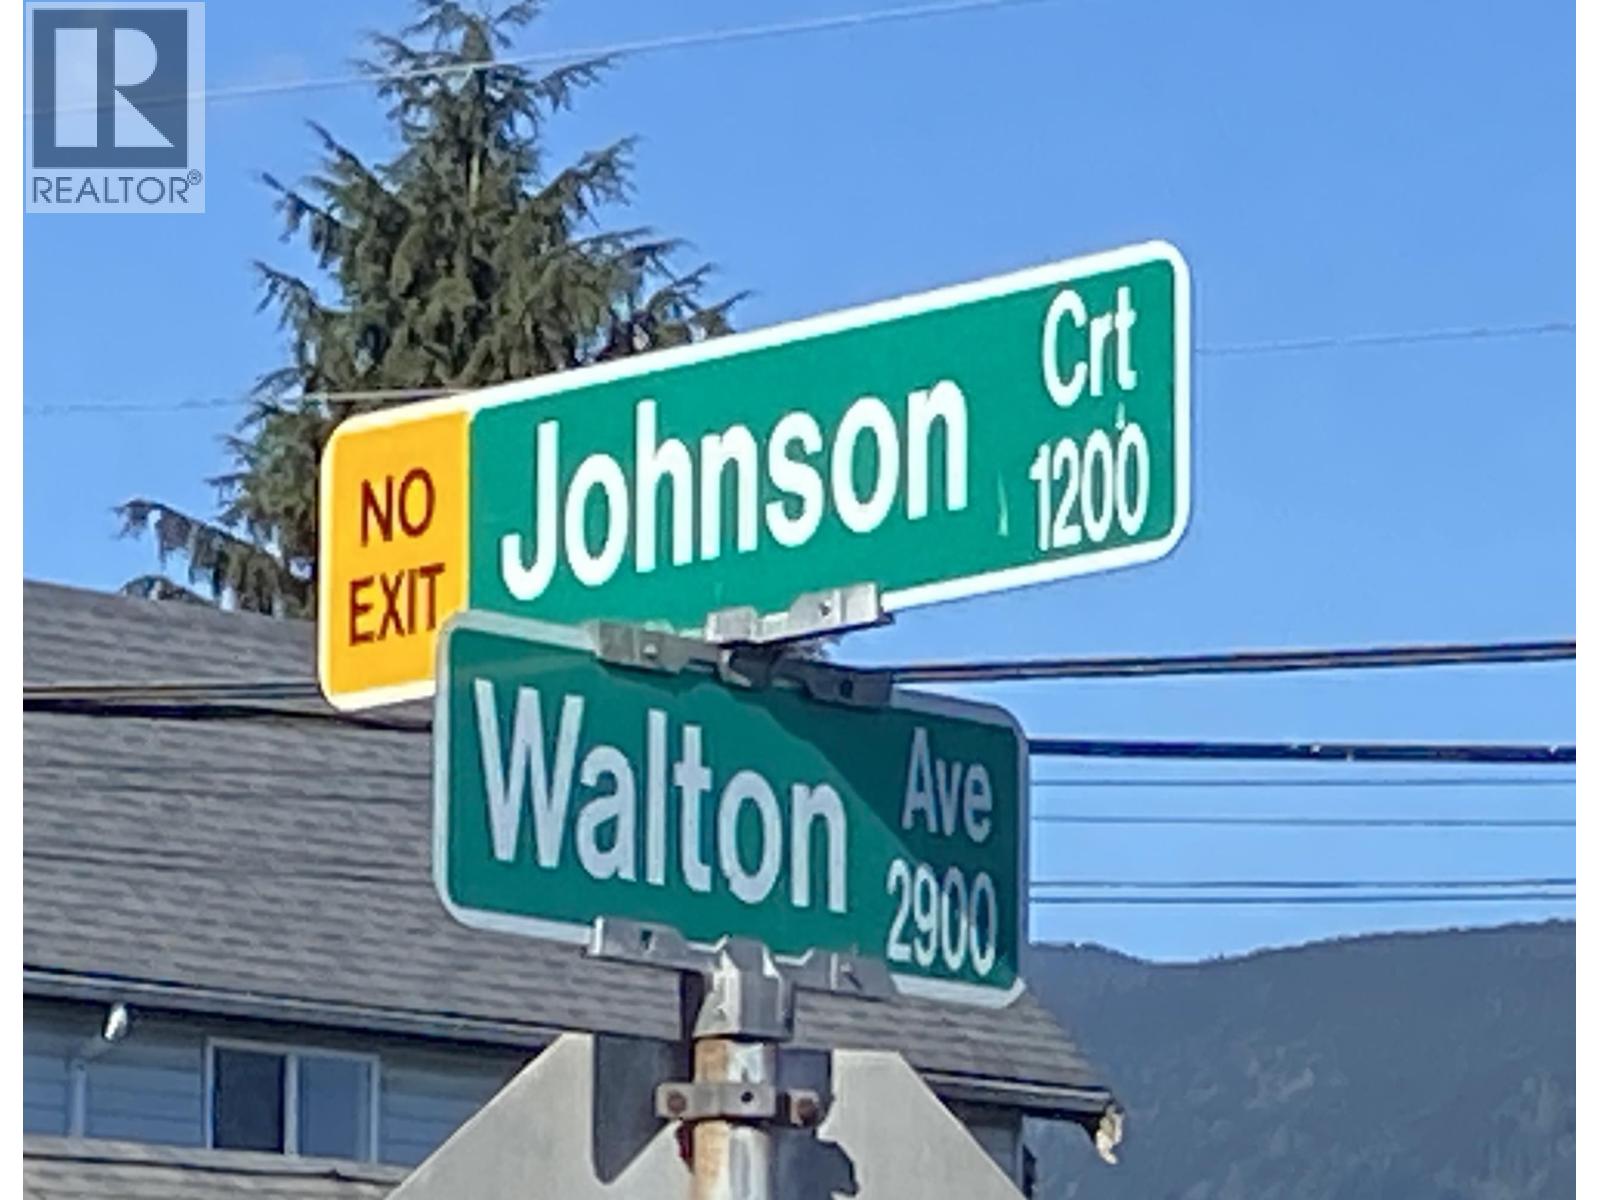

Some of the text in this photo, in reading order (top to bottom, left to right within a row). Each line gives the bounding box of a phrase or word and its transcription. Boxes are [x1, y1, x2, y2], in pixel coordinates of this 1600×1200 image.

[502, 286, 1137, 601] Johnson Crt
[1029, 422, 1149, 551] 1200
[360, 466, 435, 548] NO
[348, 562, 446, 646] EXIT
[474, 678, 993, 914] Walton Ave
[886, 859, 997, 976] 2900
